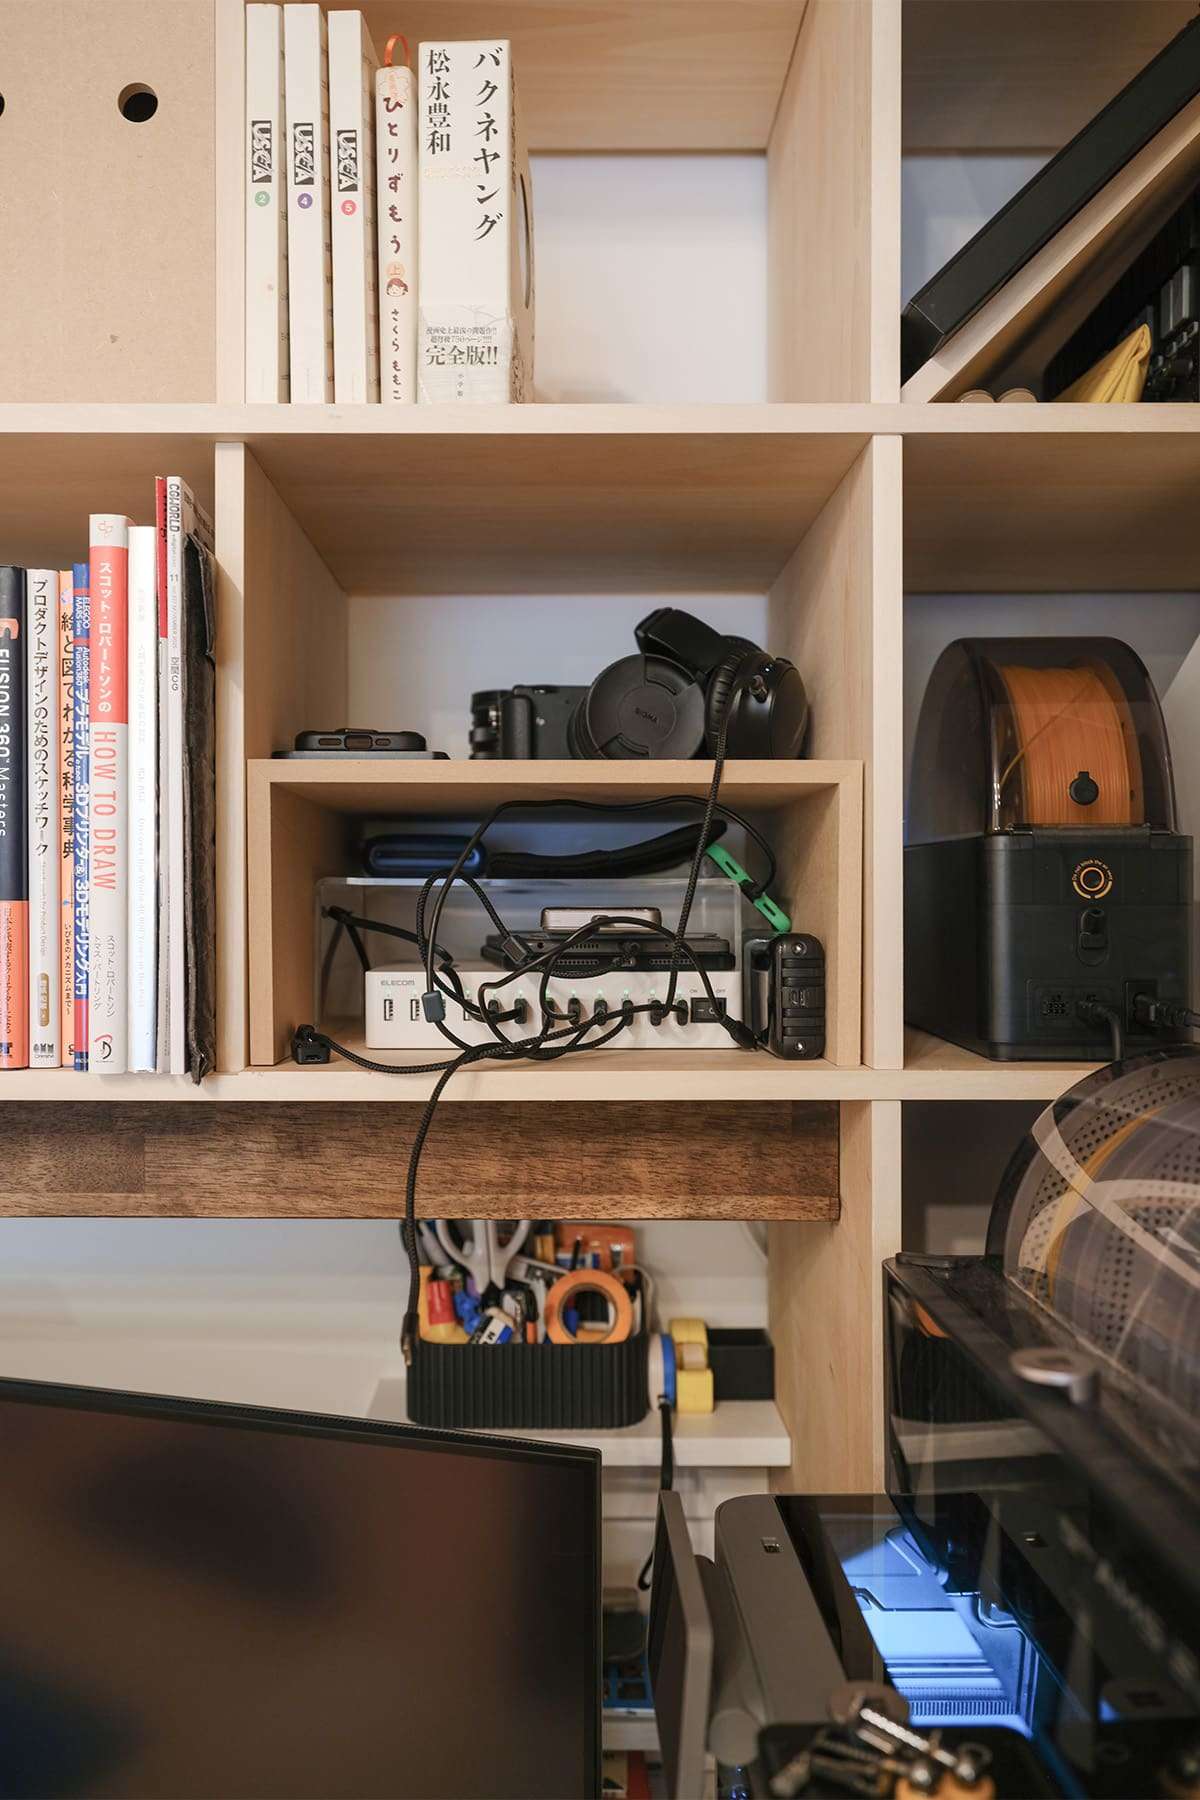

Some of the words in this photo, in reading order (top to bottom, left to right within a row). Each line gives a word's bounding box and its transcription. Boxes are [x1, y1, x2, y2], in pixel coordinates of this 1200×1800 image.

[425, 49, 452, 155] 松永豊和
[471, 47, 503, 241] バクネヤング
[383, 96, 404, 255] ひとりずもう
[425, 345, 498, 366] 完全版!!
[169, 483, 180, 533] CGWORLD
[33, 579, 49, 857] プロダクトデザインのためのスケッチワーク
[94, 731, 117, 780] HOW
[94, 790, 117, 816] TO
[94, 829, 117, 890] DRAW
